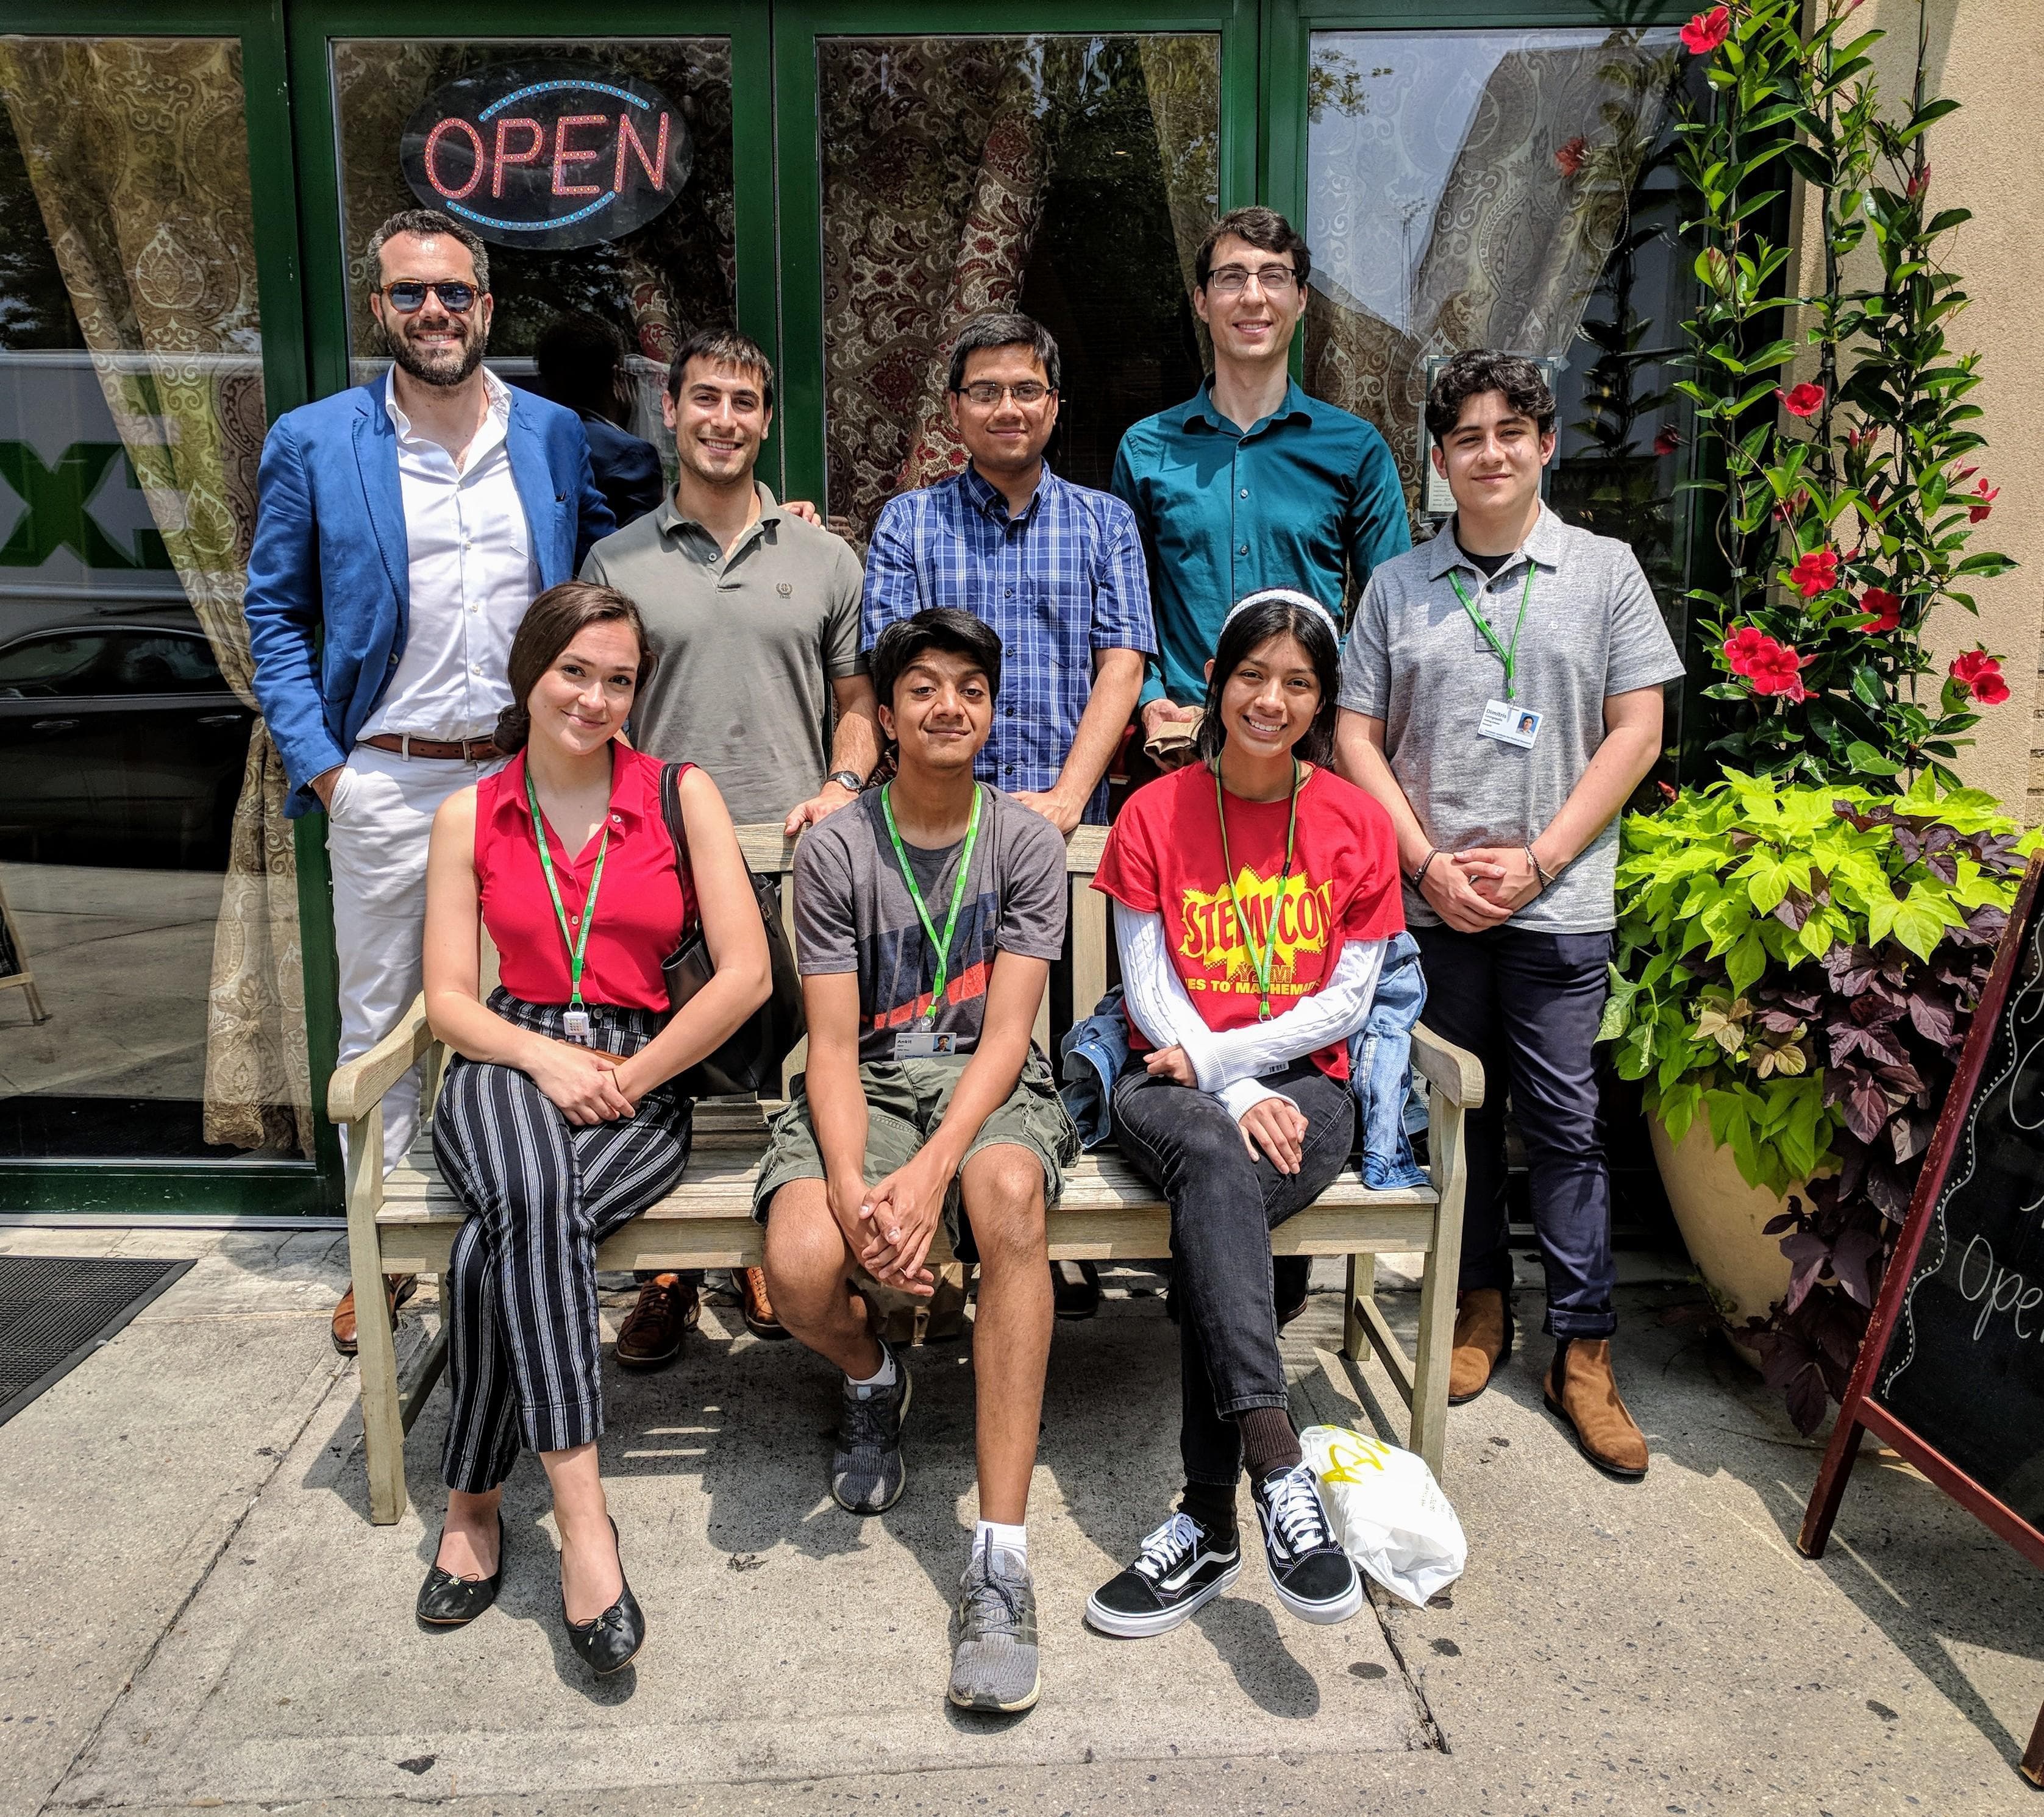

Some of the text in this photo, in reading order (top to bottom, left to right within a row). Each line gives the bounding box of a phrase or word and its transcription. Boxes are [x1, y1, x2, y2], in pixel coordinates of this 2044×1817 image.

[425, 112, 669, 198] OPEN
[1486, 709, 1507, 719] Dimitris
[533, 816, 544, 841] Northwell
[895, 845, 908, 870] Northwell
[588, 880, 599, 907] Northwell
[948, 900, 959, 925] Northwell
[577, 933, 586, 959] Northwell
[1211, 980, 1231, 993] TO
[1959, 1234, 2044, 1345] Ope
